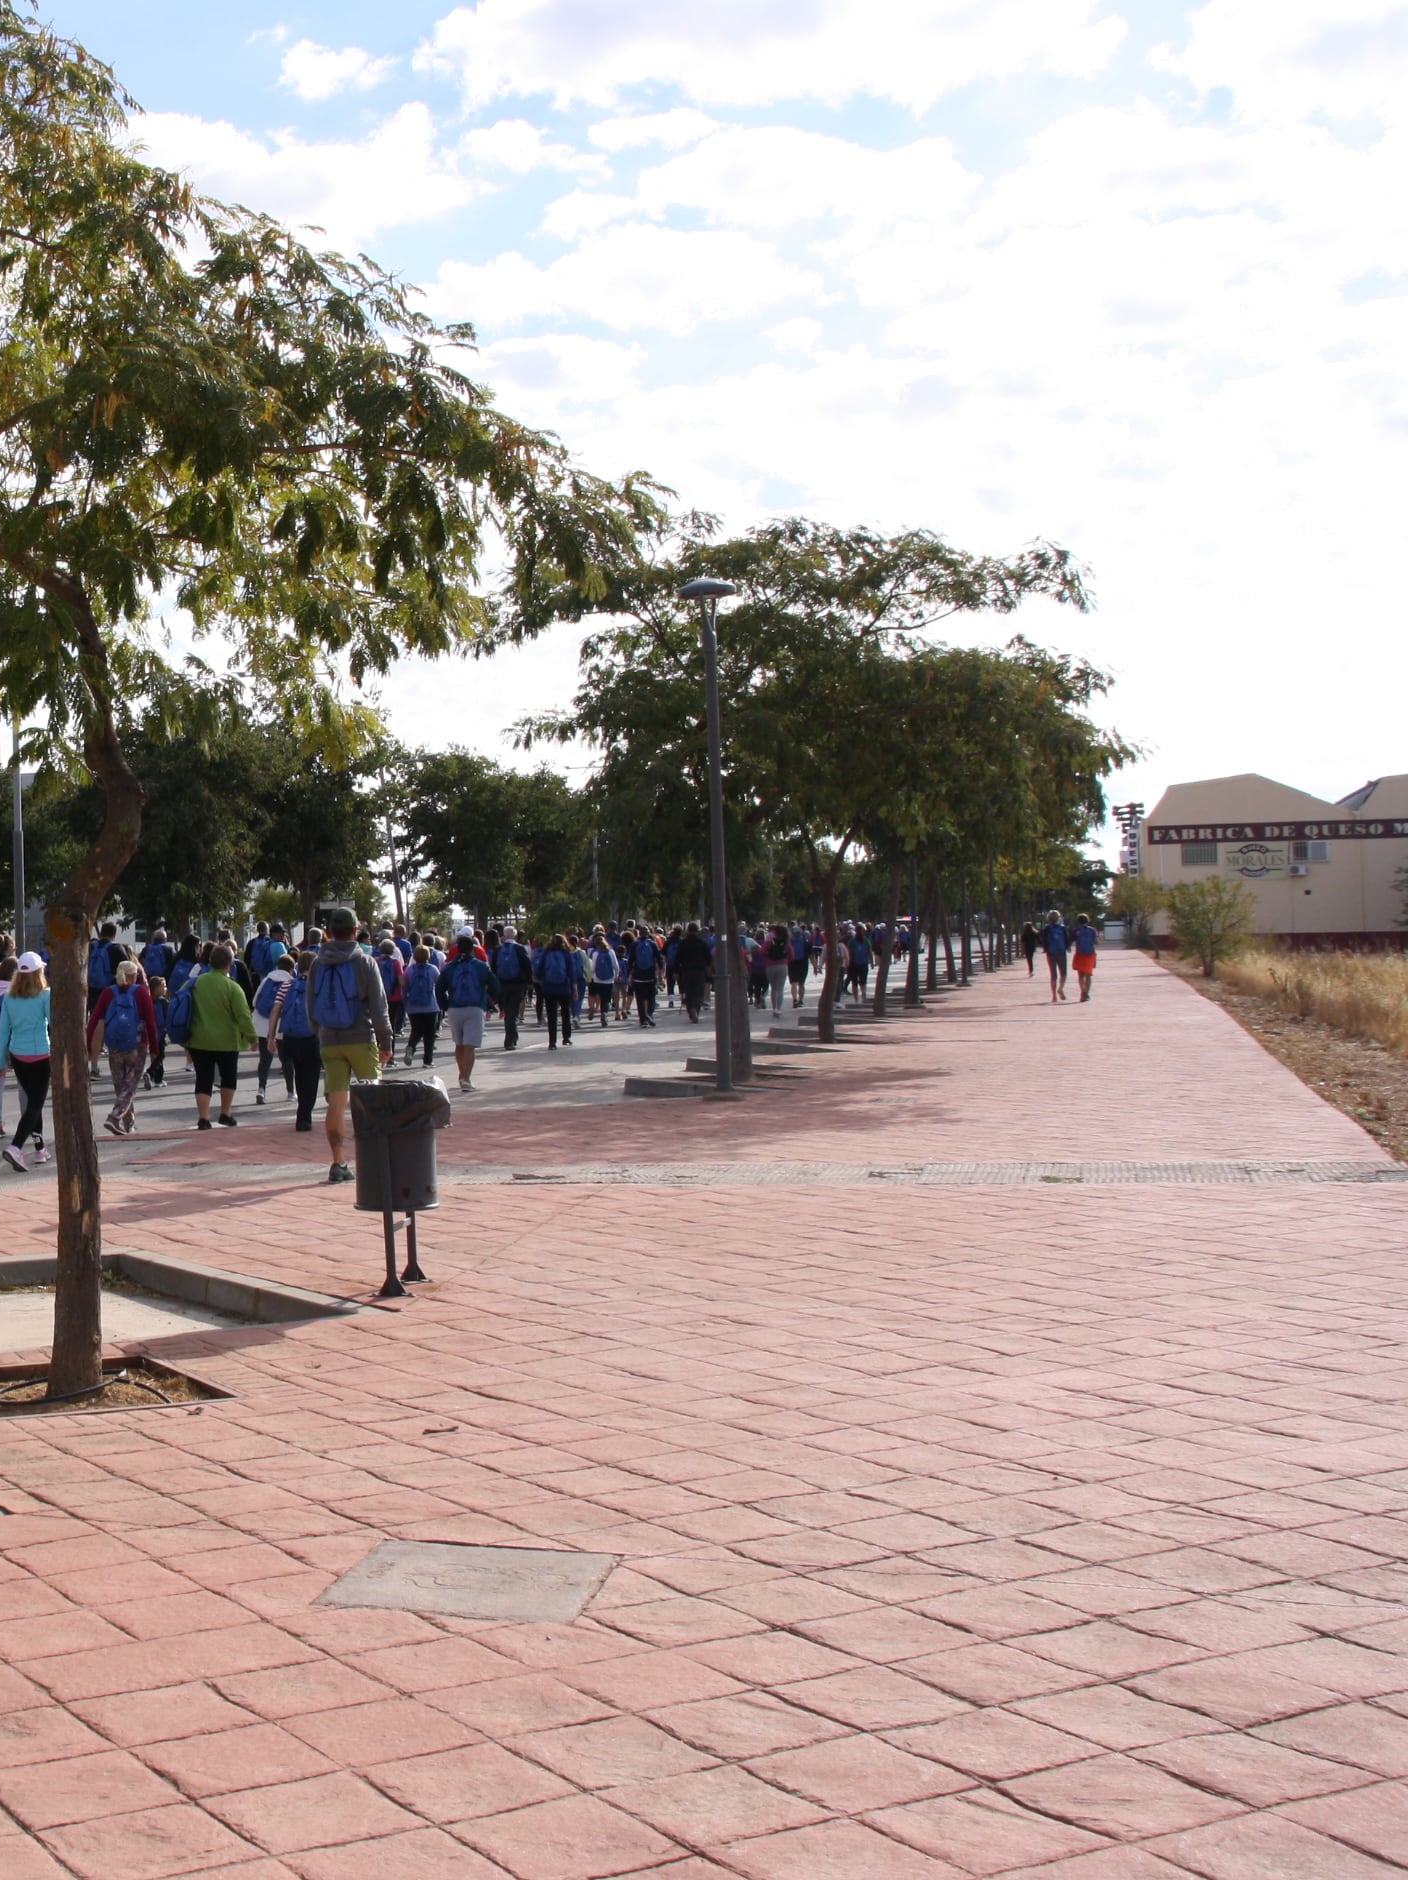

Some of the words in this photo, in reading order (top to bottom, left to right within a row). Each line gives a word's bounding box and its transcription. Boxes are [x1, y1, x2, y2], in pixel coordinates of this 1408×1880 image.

[1152, 826, 1255, 841] FABRICA
[1263, 825, 1296, 838] DE
[1303, 823, 1384, 839] QUESO
[1225, 855, 1285, 866] MORALES
